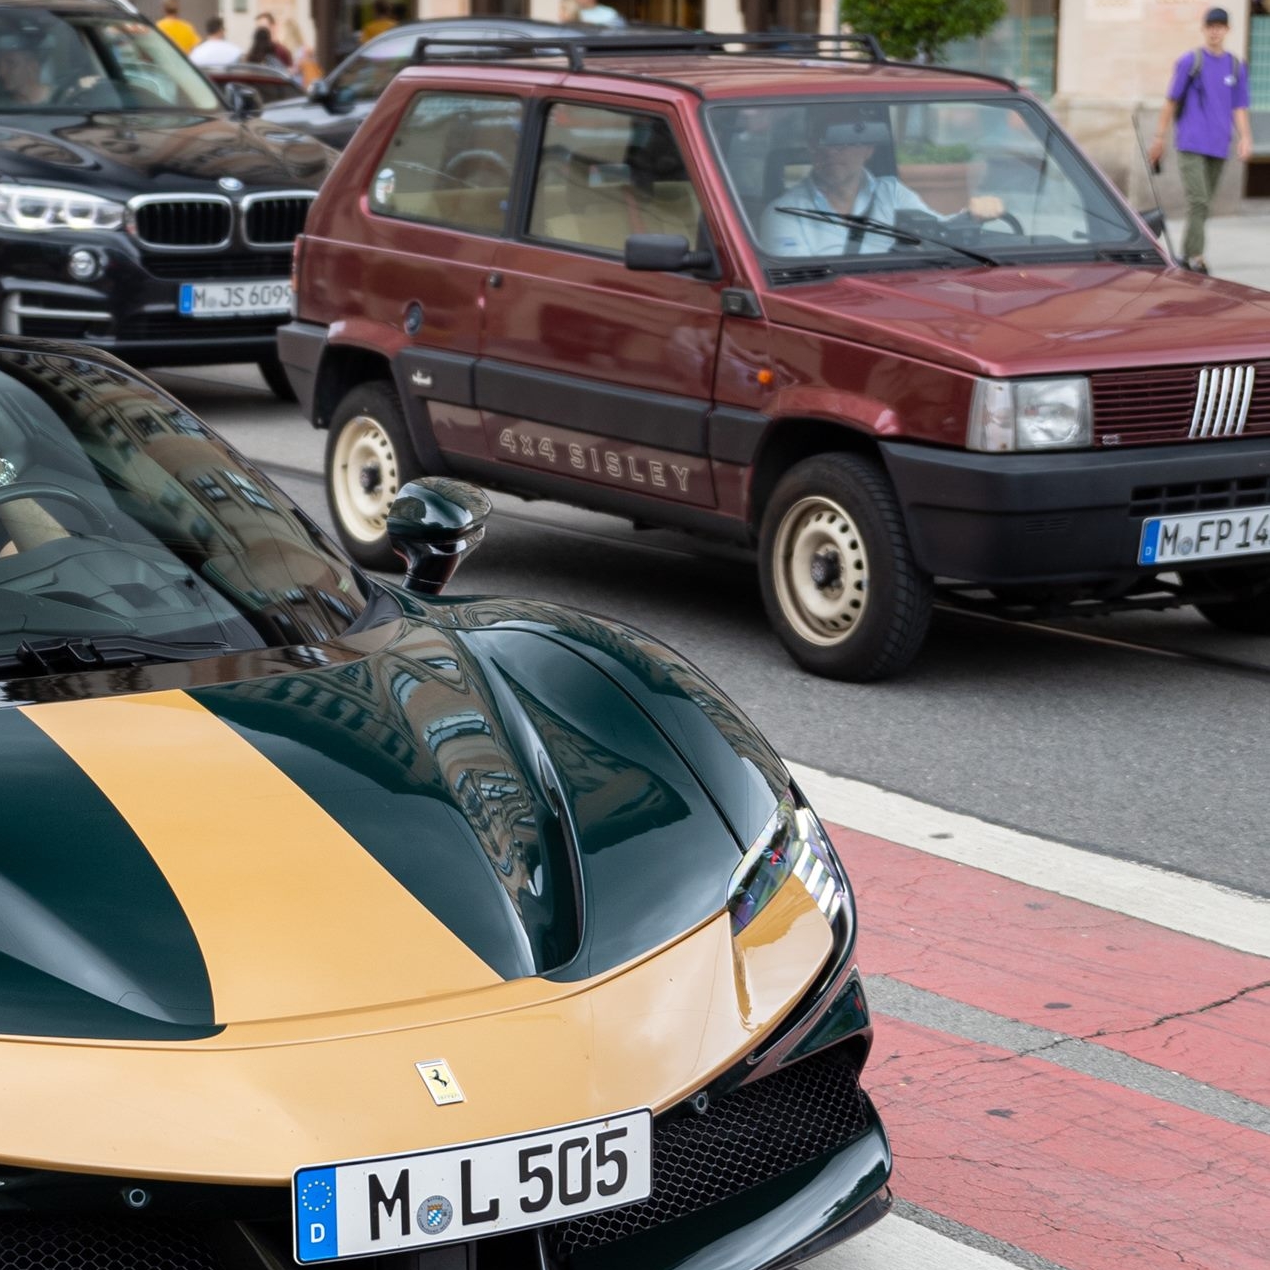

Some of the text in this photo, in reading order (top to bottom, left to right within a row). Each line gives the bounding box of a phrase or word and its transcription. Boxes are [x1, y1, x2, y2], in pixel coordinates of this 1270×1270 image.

[499, 429, 690, 492] 4x4 SISLEY
[1159, 523, 1179, 556] M
[1194, 517, 1232, 553] FP
[369, 1168, 411, 1241] M
[460, 1159, 499, 1226] L
[519, 1127, 628, 1213] 505
[310, 1223, 325, 1243] D
